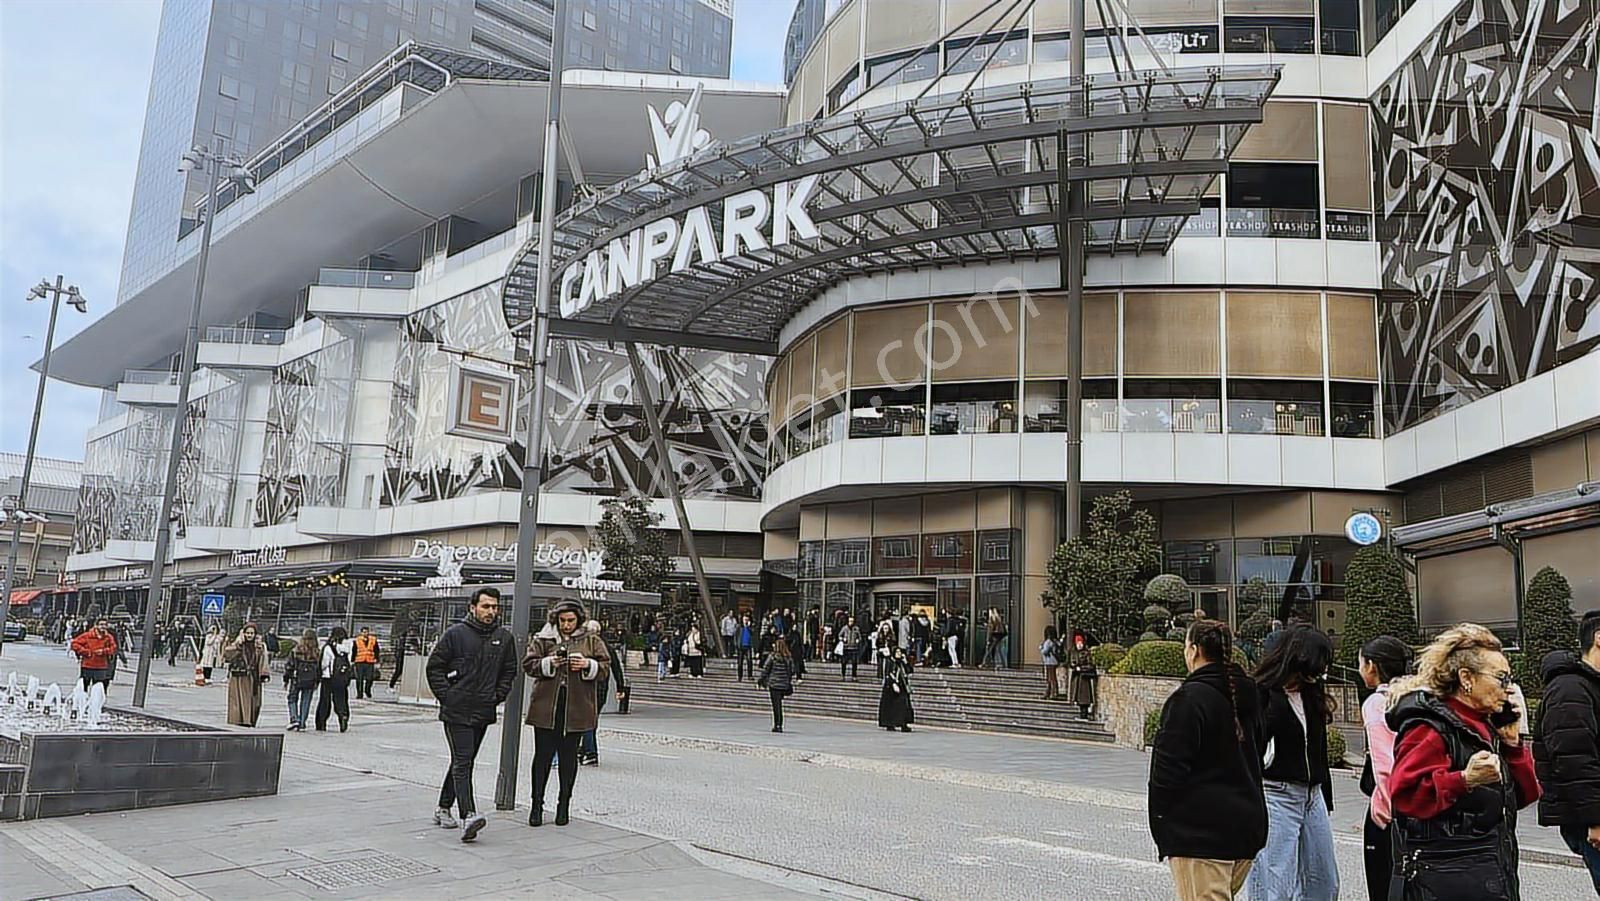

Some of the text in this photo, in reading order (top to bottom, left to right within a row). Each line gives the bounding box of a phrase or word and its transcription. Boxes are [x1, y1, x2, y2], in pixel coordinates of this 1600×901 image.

[1273, 220, 1317, 232] TEASHOP
[1326, 223, 1368, 235] TEASHOP
[560, 173, 820, 319] CANPARK
[469, 381, 501, 426] E
[562, 576, 625, 592] CANPARK
[580, 590, 606, 600] VALE
